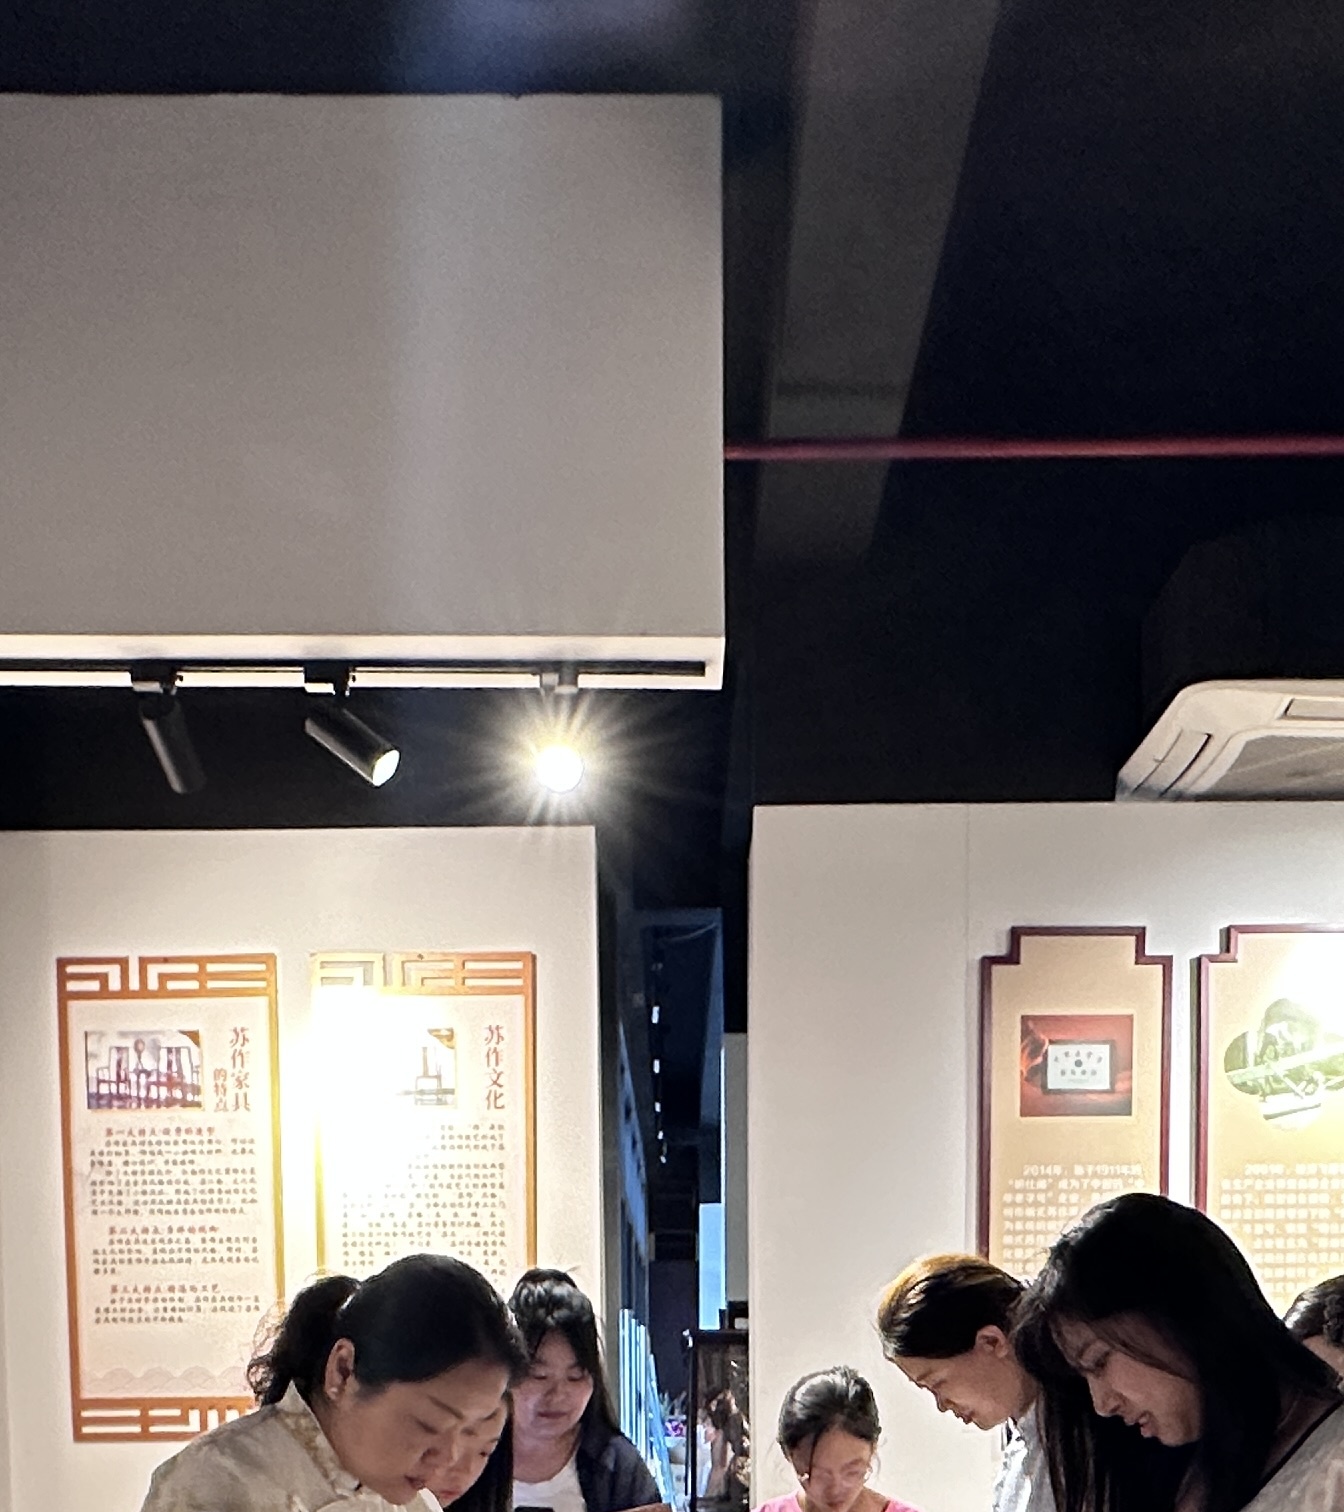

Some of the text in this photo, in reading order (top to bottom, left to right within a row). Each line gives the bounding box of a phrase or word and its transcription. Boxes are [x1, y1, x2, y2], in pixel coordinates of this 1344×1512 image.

[213, 1067, 229, 1112] 的特点
[229, 1026, 251, 1112] 苏作家具
[485, 1024, 505, 1110] 苏作文化
